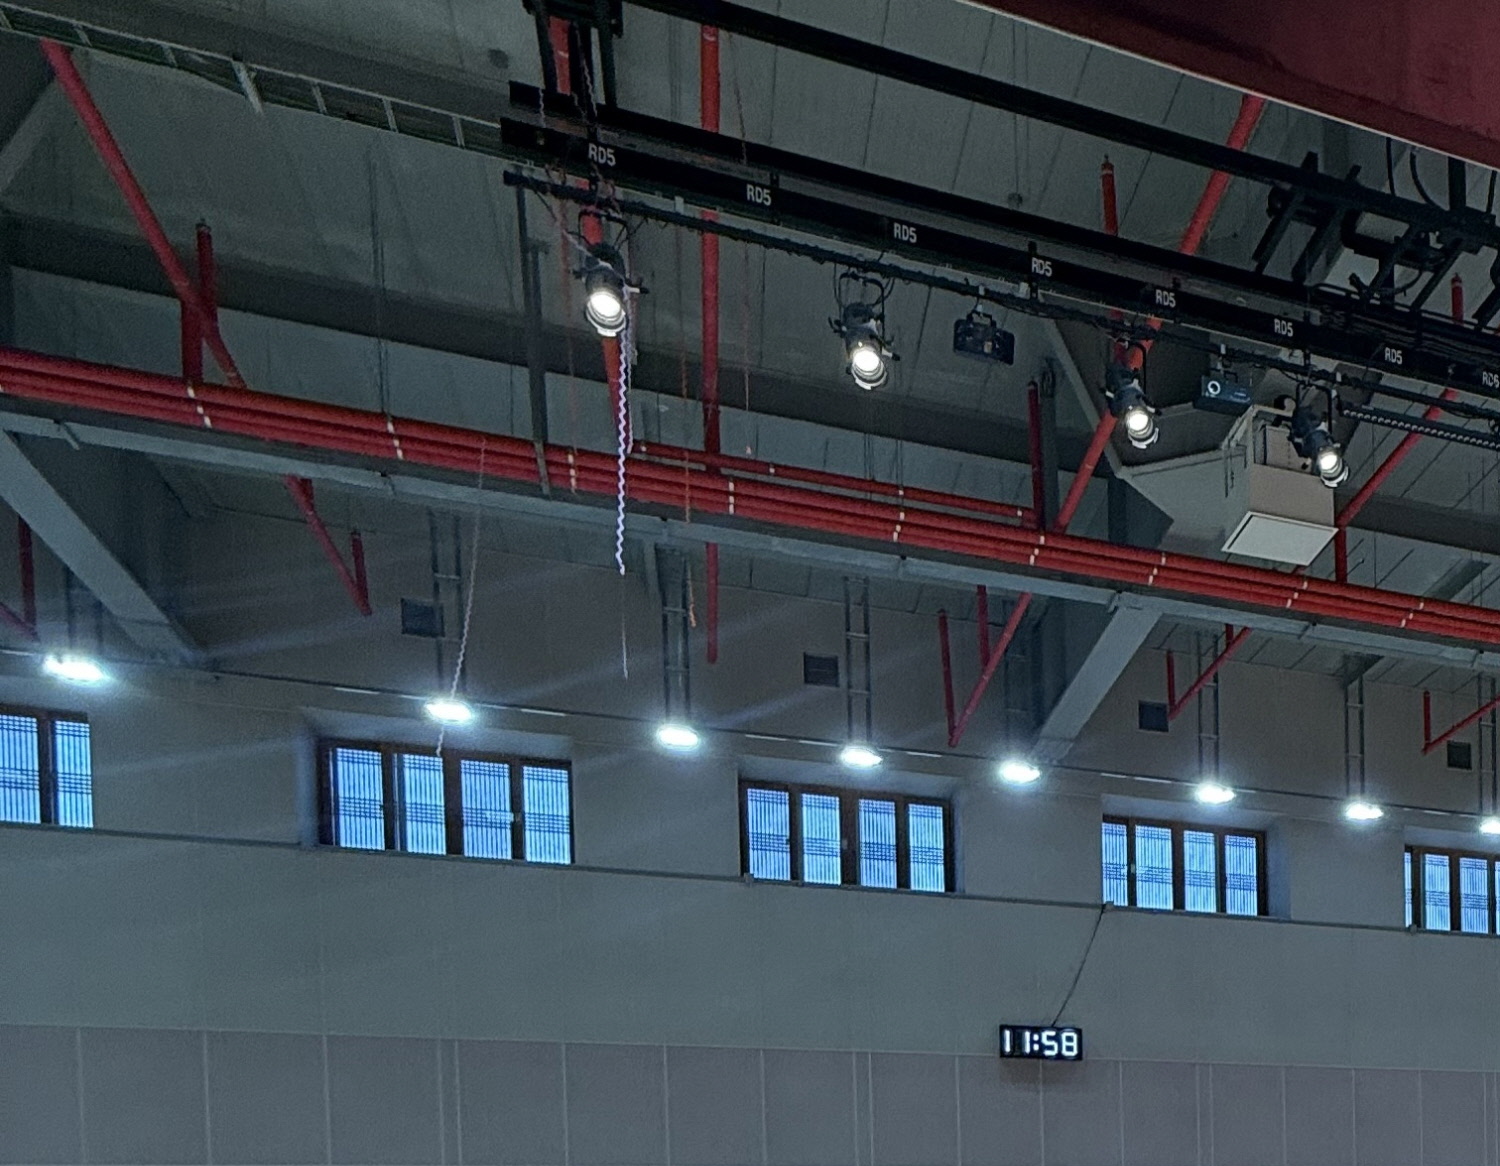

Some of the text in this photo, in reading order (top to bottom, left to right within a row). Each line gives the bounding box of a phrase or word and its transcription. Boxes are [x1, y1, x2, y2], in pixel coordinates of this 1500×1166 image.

[588, 142, 616, 167] RD5
[746, 184, 771, 206] RD5
[893, 222, 917, 244] RD5
[1031, 257, 1052, 277] RD5
[1156, 289, 1176, 308] RD5
[1274, 318, 1293, 337] RD5
[1384, 347, 1402, 364] RD5
[1003, 1028, 1078, 1057] 11:58
